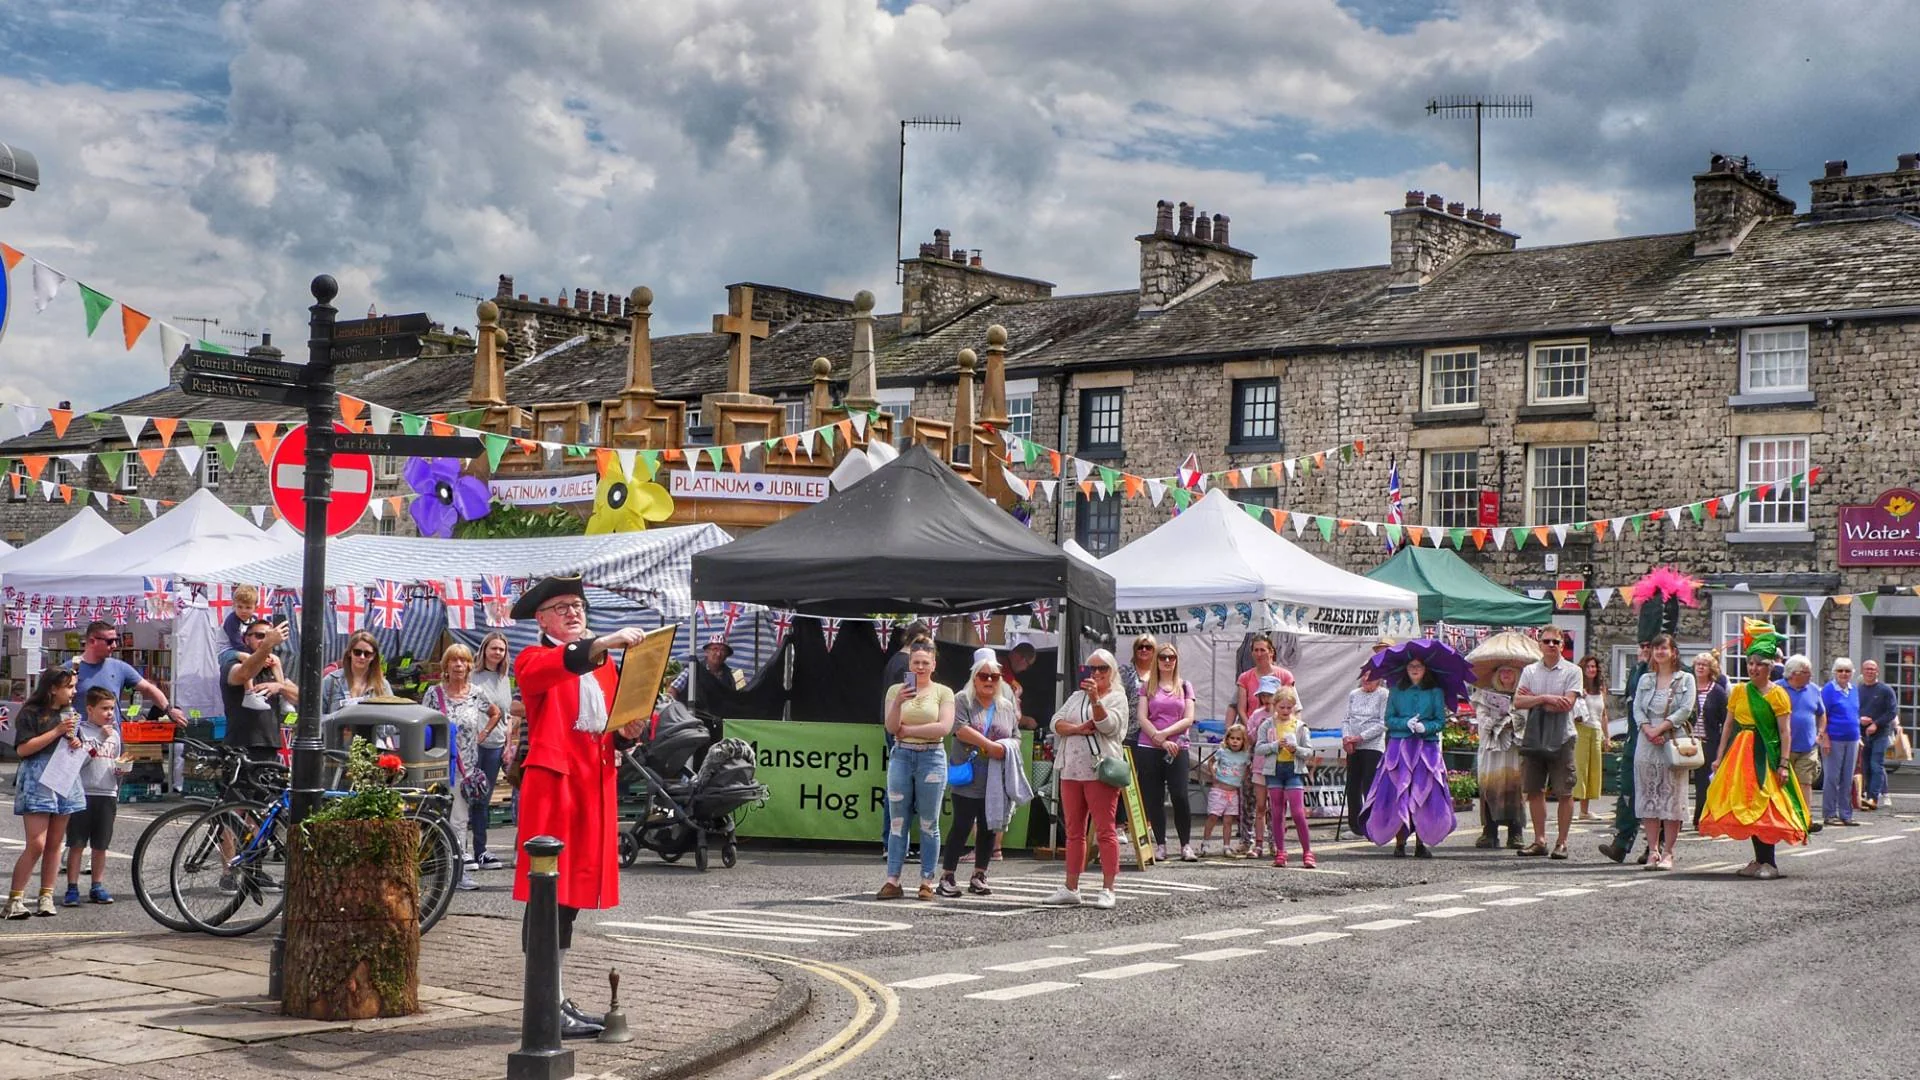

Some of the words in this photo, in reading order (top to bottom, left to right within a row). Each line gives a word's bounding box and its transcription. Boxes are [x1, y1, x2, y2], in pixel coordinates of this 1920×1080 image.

[379, 319, 400, 335] Hall
[329, 347, 345, 360] Post
[345, 344, 368, 358] Office
[193, 354, 229, 370] Tourist
[232, 358, 291, 378] Information
[192, 378, 234, 395] Ruskin's
[236, 383, 260, 397] View
[334, 437, 357, 449] Car
[360, 437, 391, 449] Parks
[492, 485, 548, 500] PLATINUM
[558, 480, 594, 498] JUBILEE
[675, 476, 750, 494] PLATINUM
[767, 481, 825, 498] JUBILEE
[1845, 521, 1910, 539] Water
[1851, 549, 1890, 557] CHINESE
[1132, 607, 1181, 623] FISH
[1314, 607, 1355, 624] FRESH
[1355, 609, 1380, 625] FISH
[1116, 622, 1188, 635] LEETWOOD
[1308, 622, 1333, 635] FROM
[1333, 624, 1379, 636] FLEETWOOD
[799, 784, 859, 819] Hog
